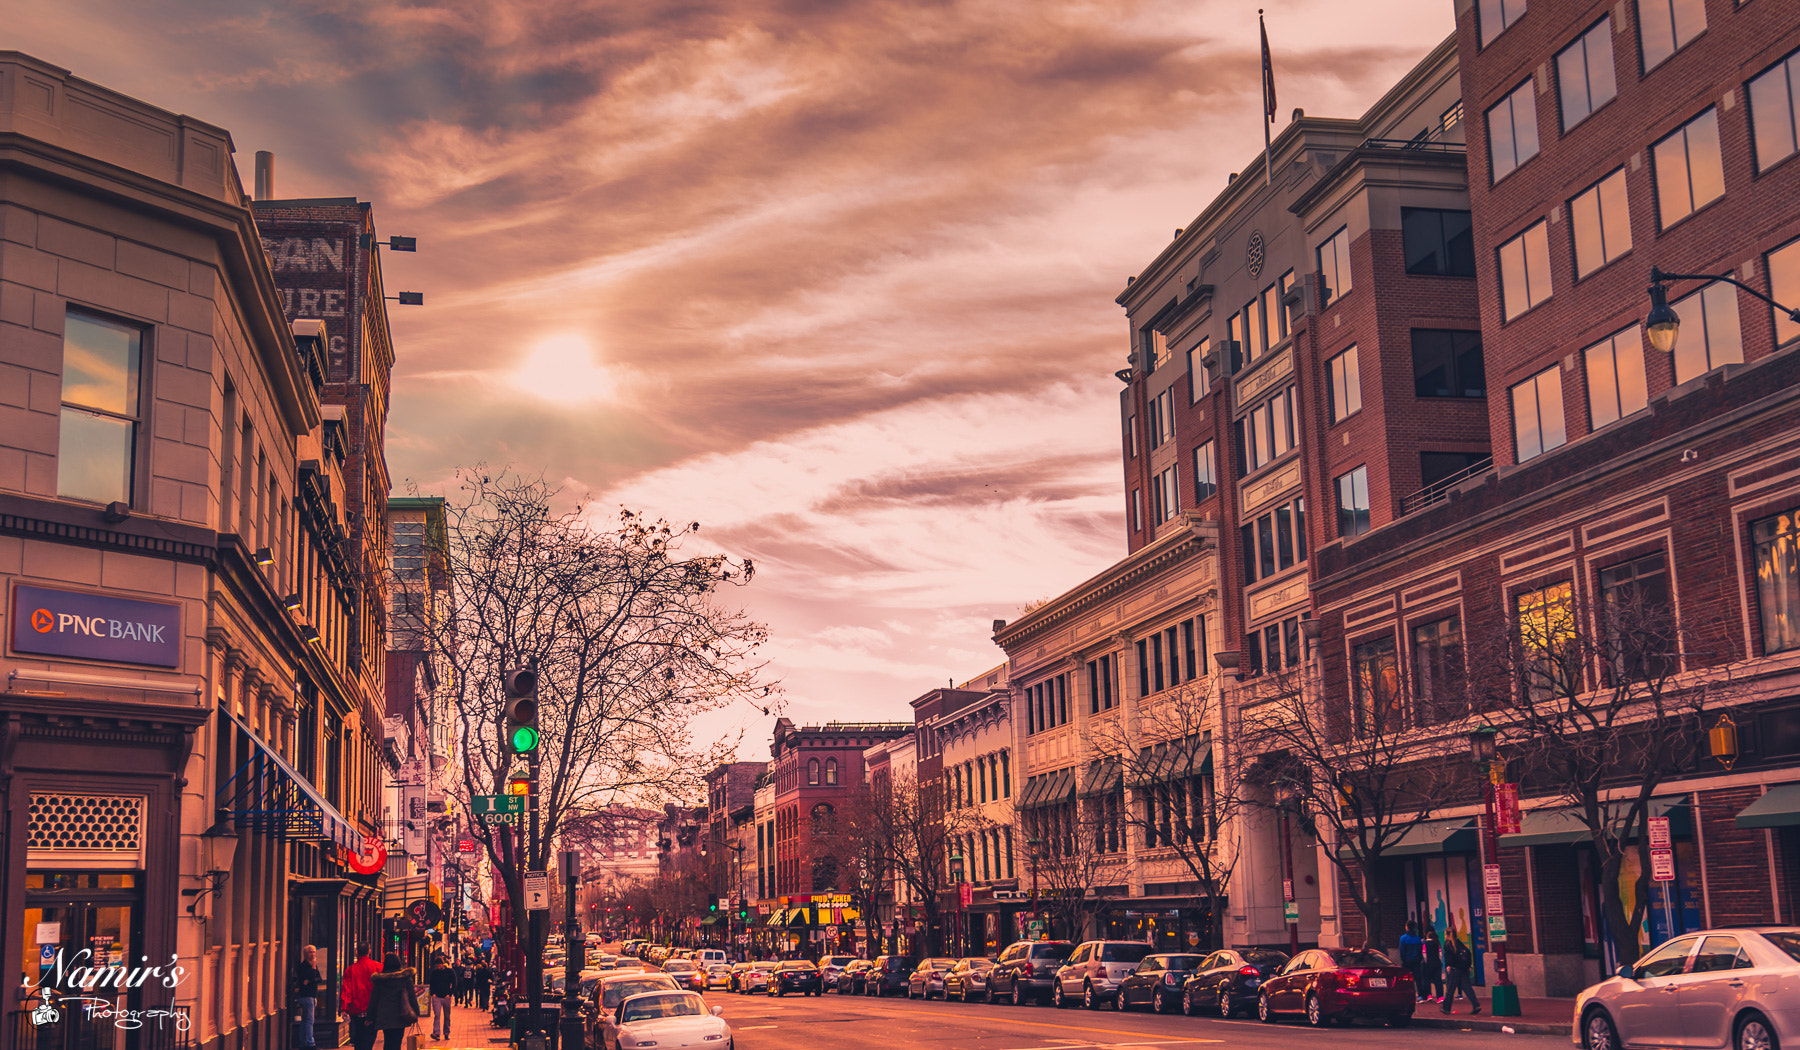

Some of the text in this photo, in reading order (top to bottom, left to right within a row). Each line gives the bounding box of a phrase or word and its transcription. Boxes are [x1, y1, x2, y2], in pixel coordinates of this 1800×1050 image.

[57, 613, 165, 643] PNC BANK
[487, 797, 496, 811] I
[485, 813, 513, 823] 600
[364, 837, 385, 851] OTERS
